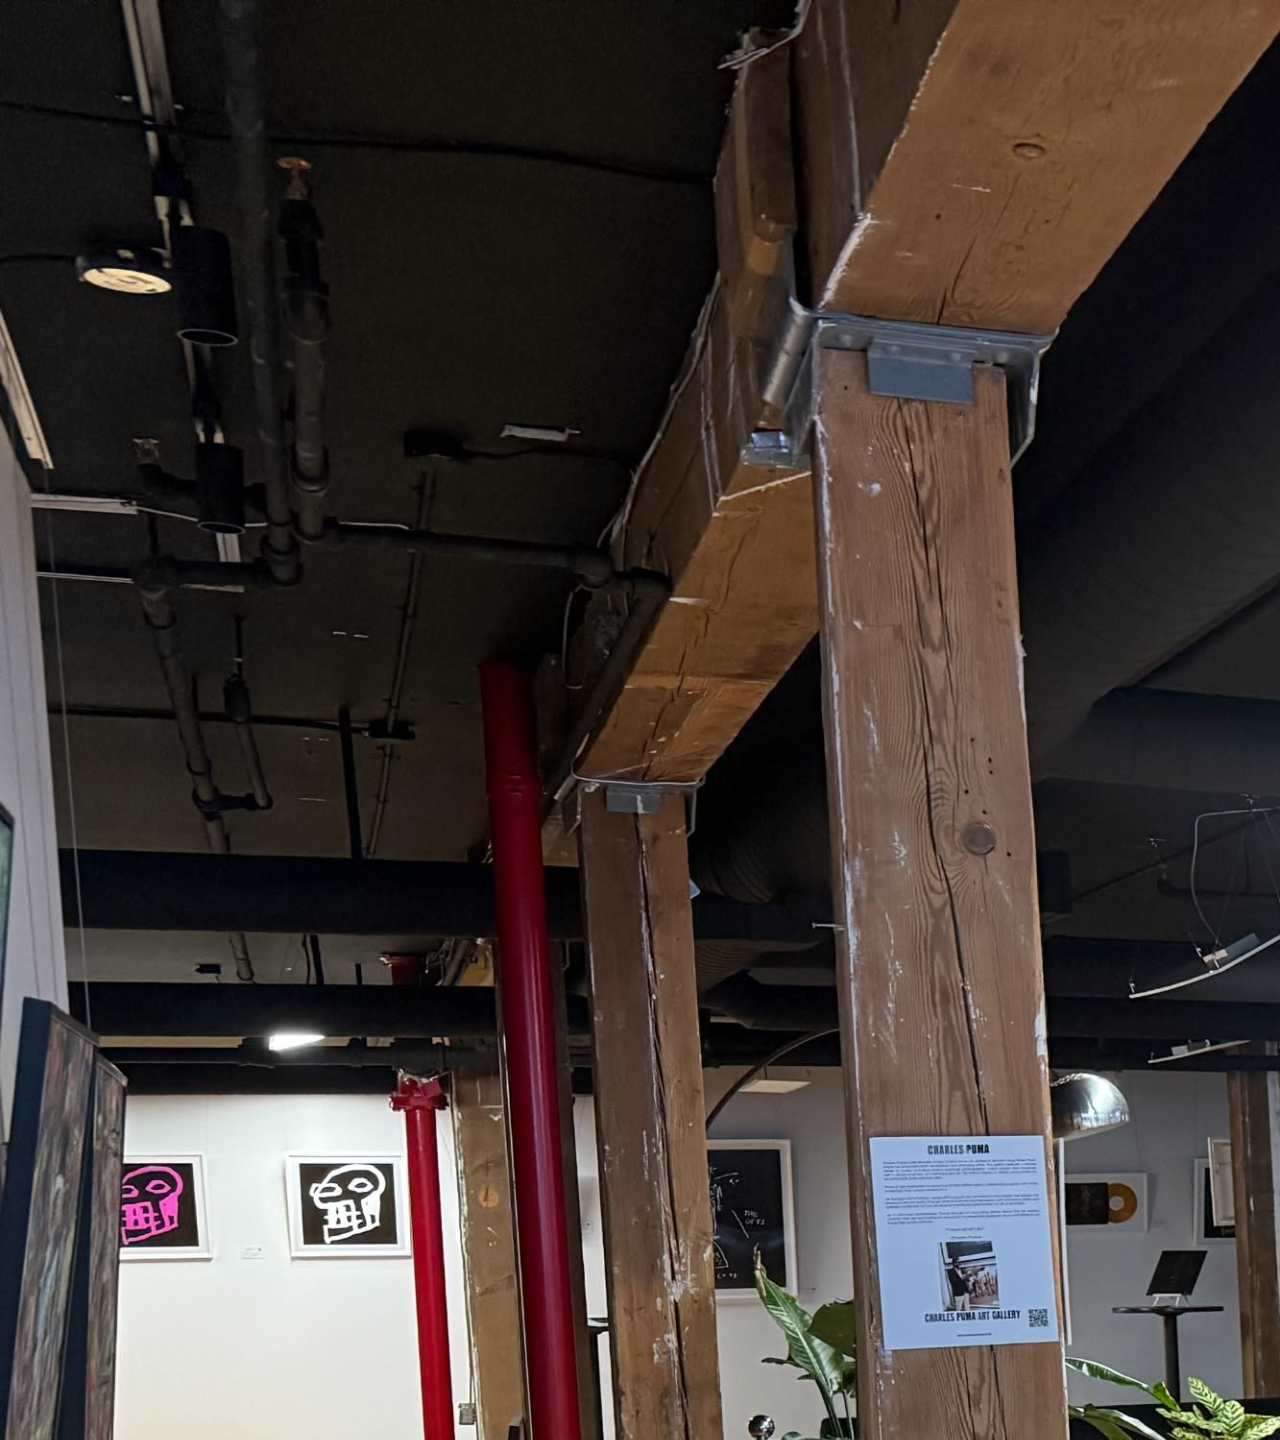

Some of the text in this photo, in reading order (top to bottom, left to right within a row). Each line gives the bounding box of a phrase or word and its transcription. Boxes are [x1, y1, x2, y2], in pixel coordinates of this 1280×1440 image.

[927, 1143, 990, 1155] CHARLES PUMA
[925, 1310, 1021, 1322] CHARLES PUMA ART GALLERY
